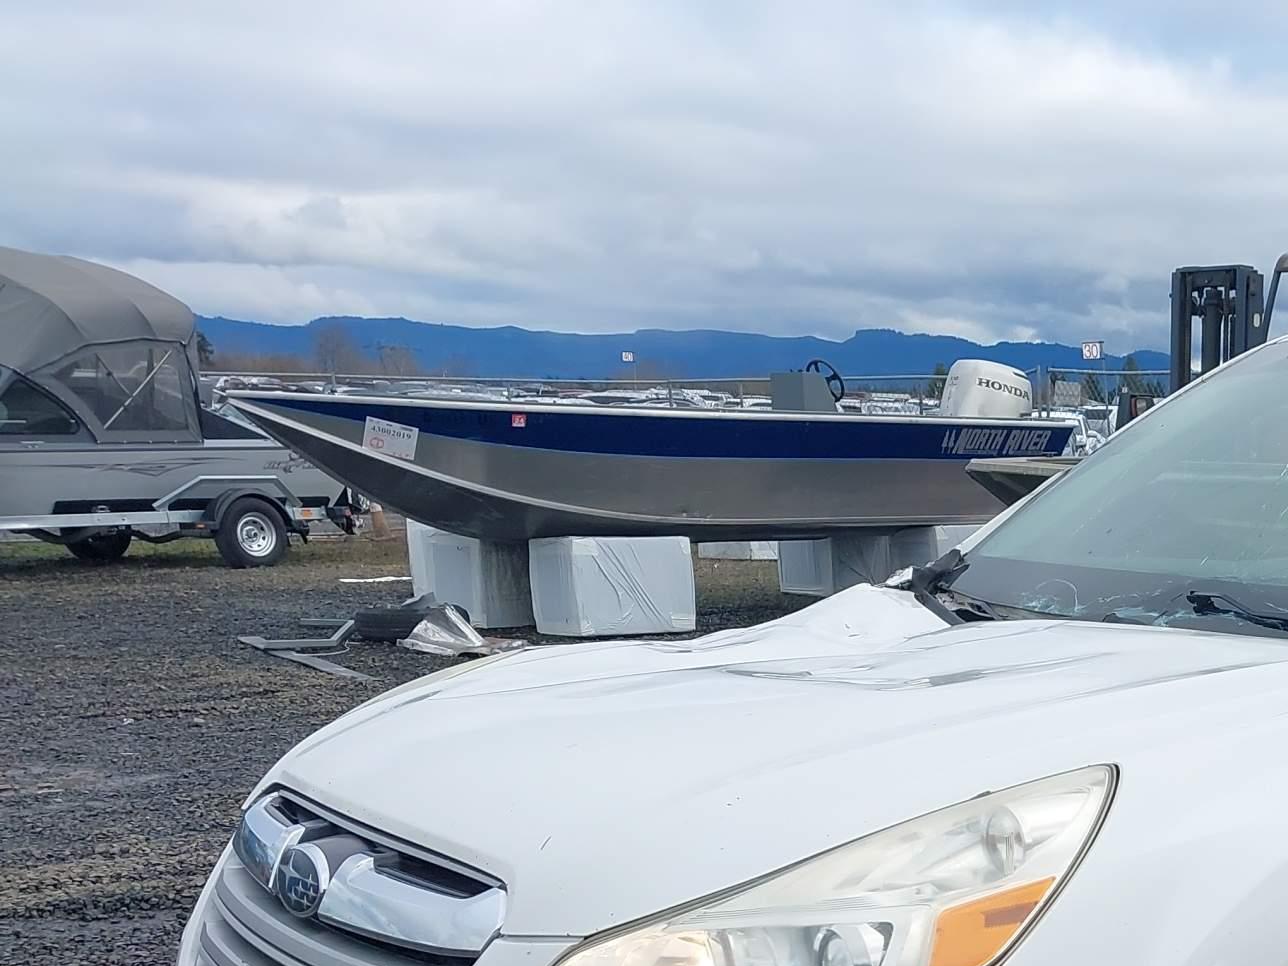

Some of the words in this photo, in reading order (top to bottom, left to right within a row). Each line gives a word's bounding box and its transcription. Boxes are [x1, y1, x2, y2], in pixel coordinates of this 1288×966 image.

[1084, 343, 1099, 359] 30
[976, 377, 1031, 401] HONDA
[955, 428, 1005, 455] NORTH
[1002, 430, 1052, 455] RIVER
